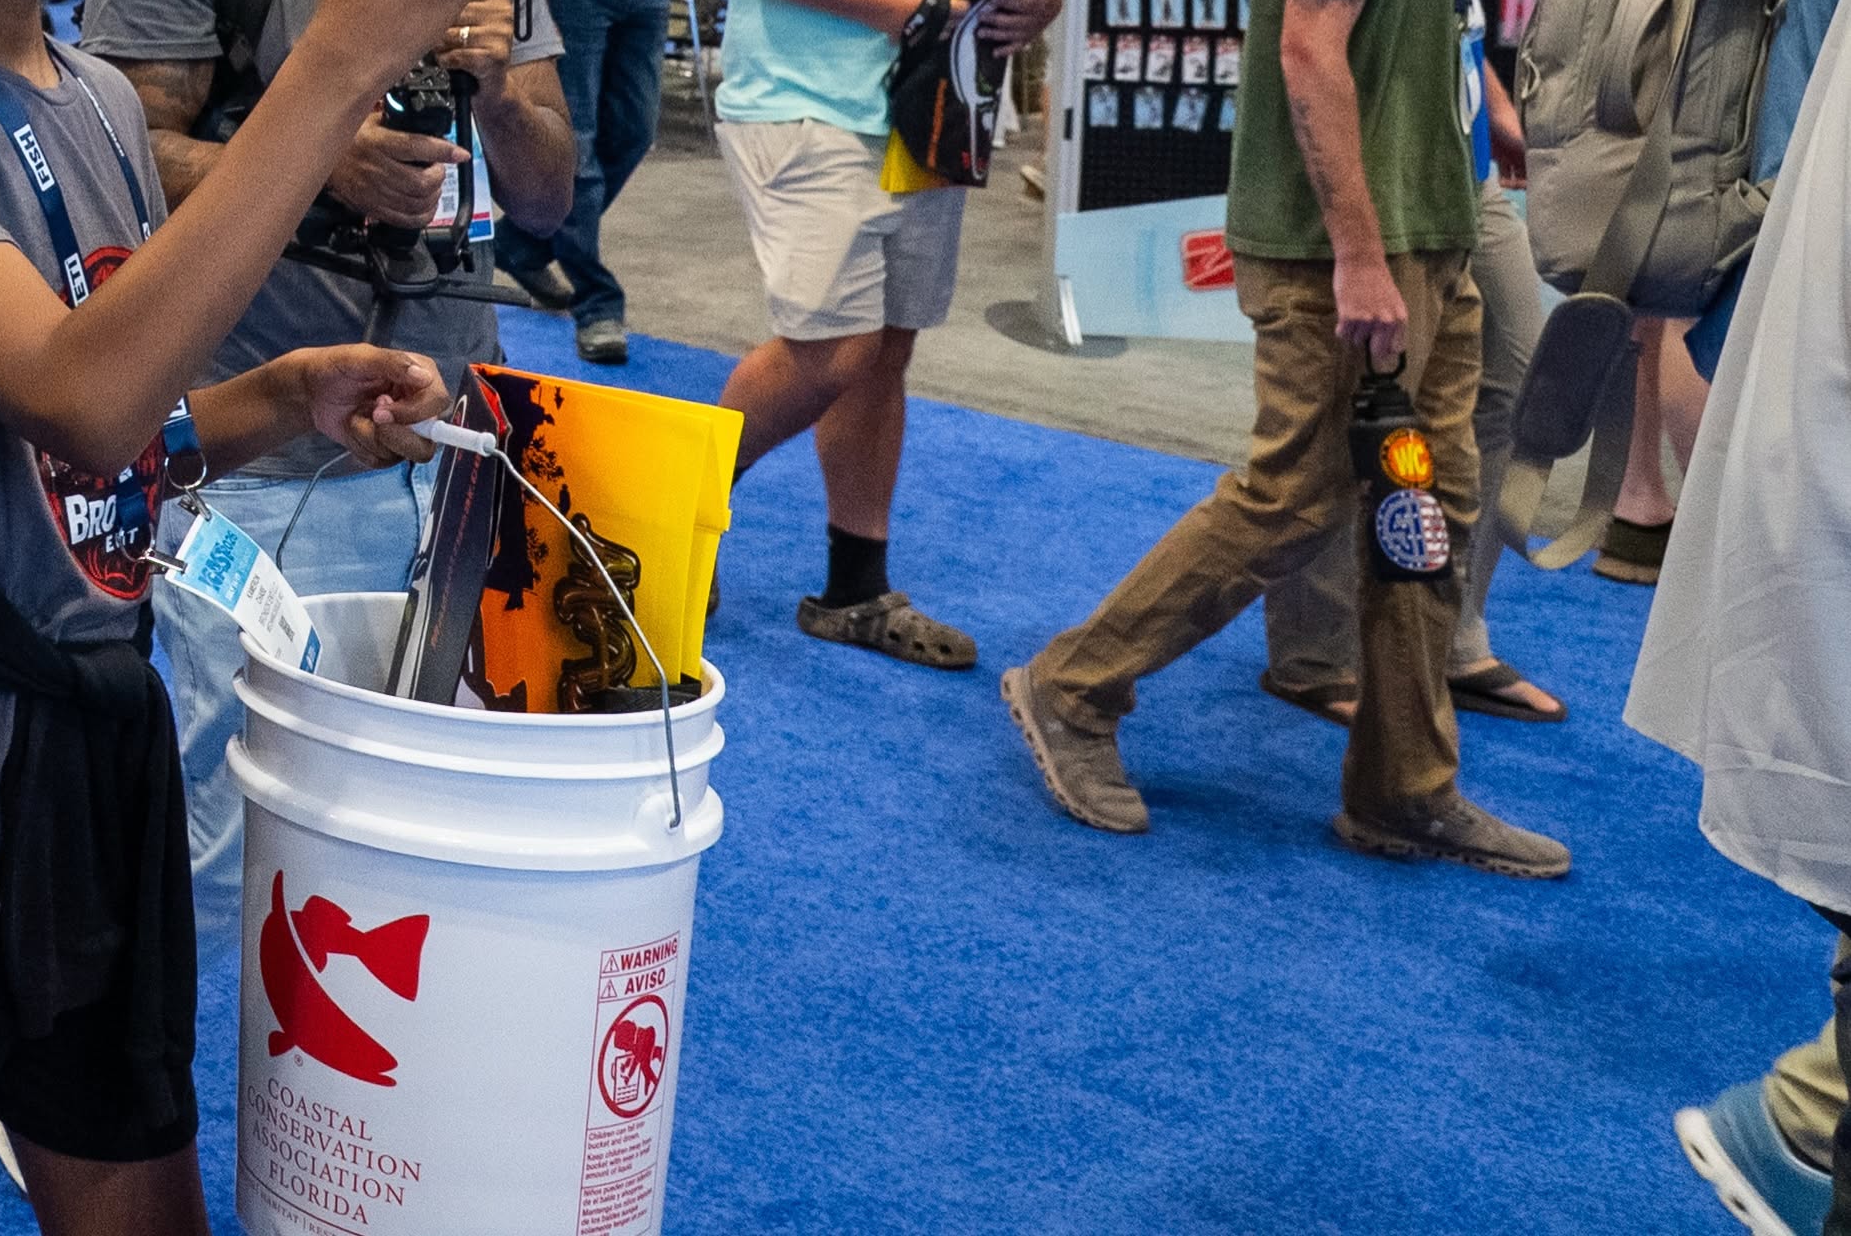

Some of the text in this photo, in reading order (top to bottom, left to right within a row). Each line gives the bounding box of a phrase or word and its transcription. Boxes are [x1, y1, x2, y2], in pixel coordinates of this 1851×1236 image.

[18, 128, 51, 188] FISH
[66, 257, 87, 303] ETI
[620, 937, 678, 971] WARNING
[624, 967, 666, 995] AVISO
[248, 1085, 422, 1182] CONSERVATION
[267, 1077, 373, 1142] COASTAL
[253, 1119, 406, 1207] ASSOCIATION
[269, 1160, 369, 1225] FLORIDA
